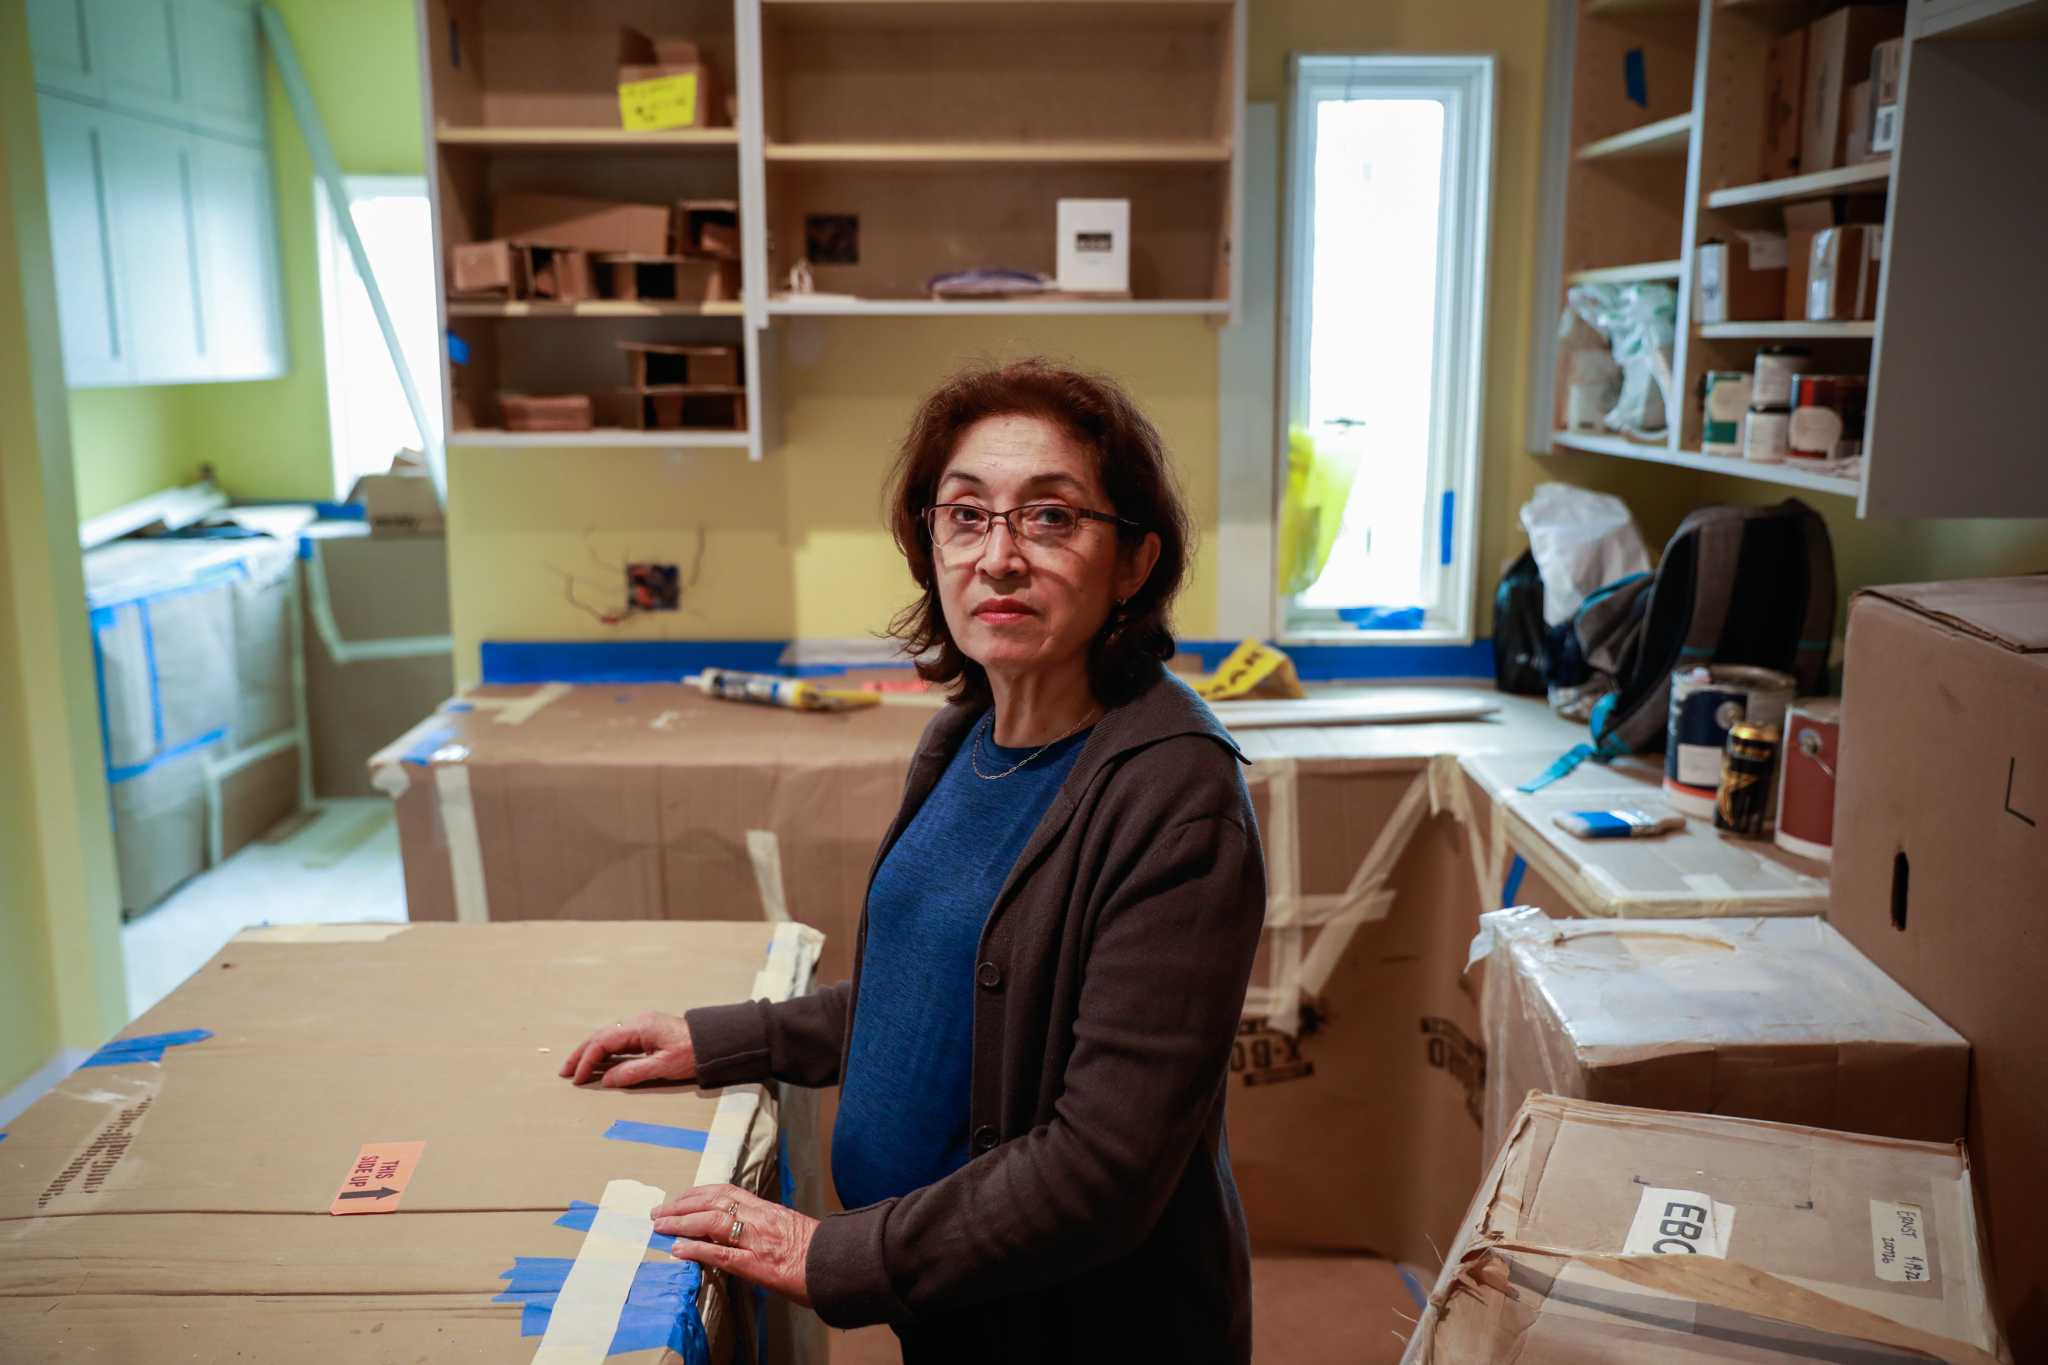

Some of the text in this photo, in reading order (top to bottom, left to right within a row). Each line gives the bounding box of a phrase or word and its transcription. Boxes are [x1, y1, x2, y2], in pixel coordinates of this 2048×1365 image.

[348, 1155, 380, 1187] SIDE UP
[375, 1160, 401, 1179] THIS
